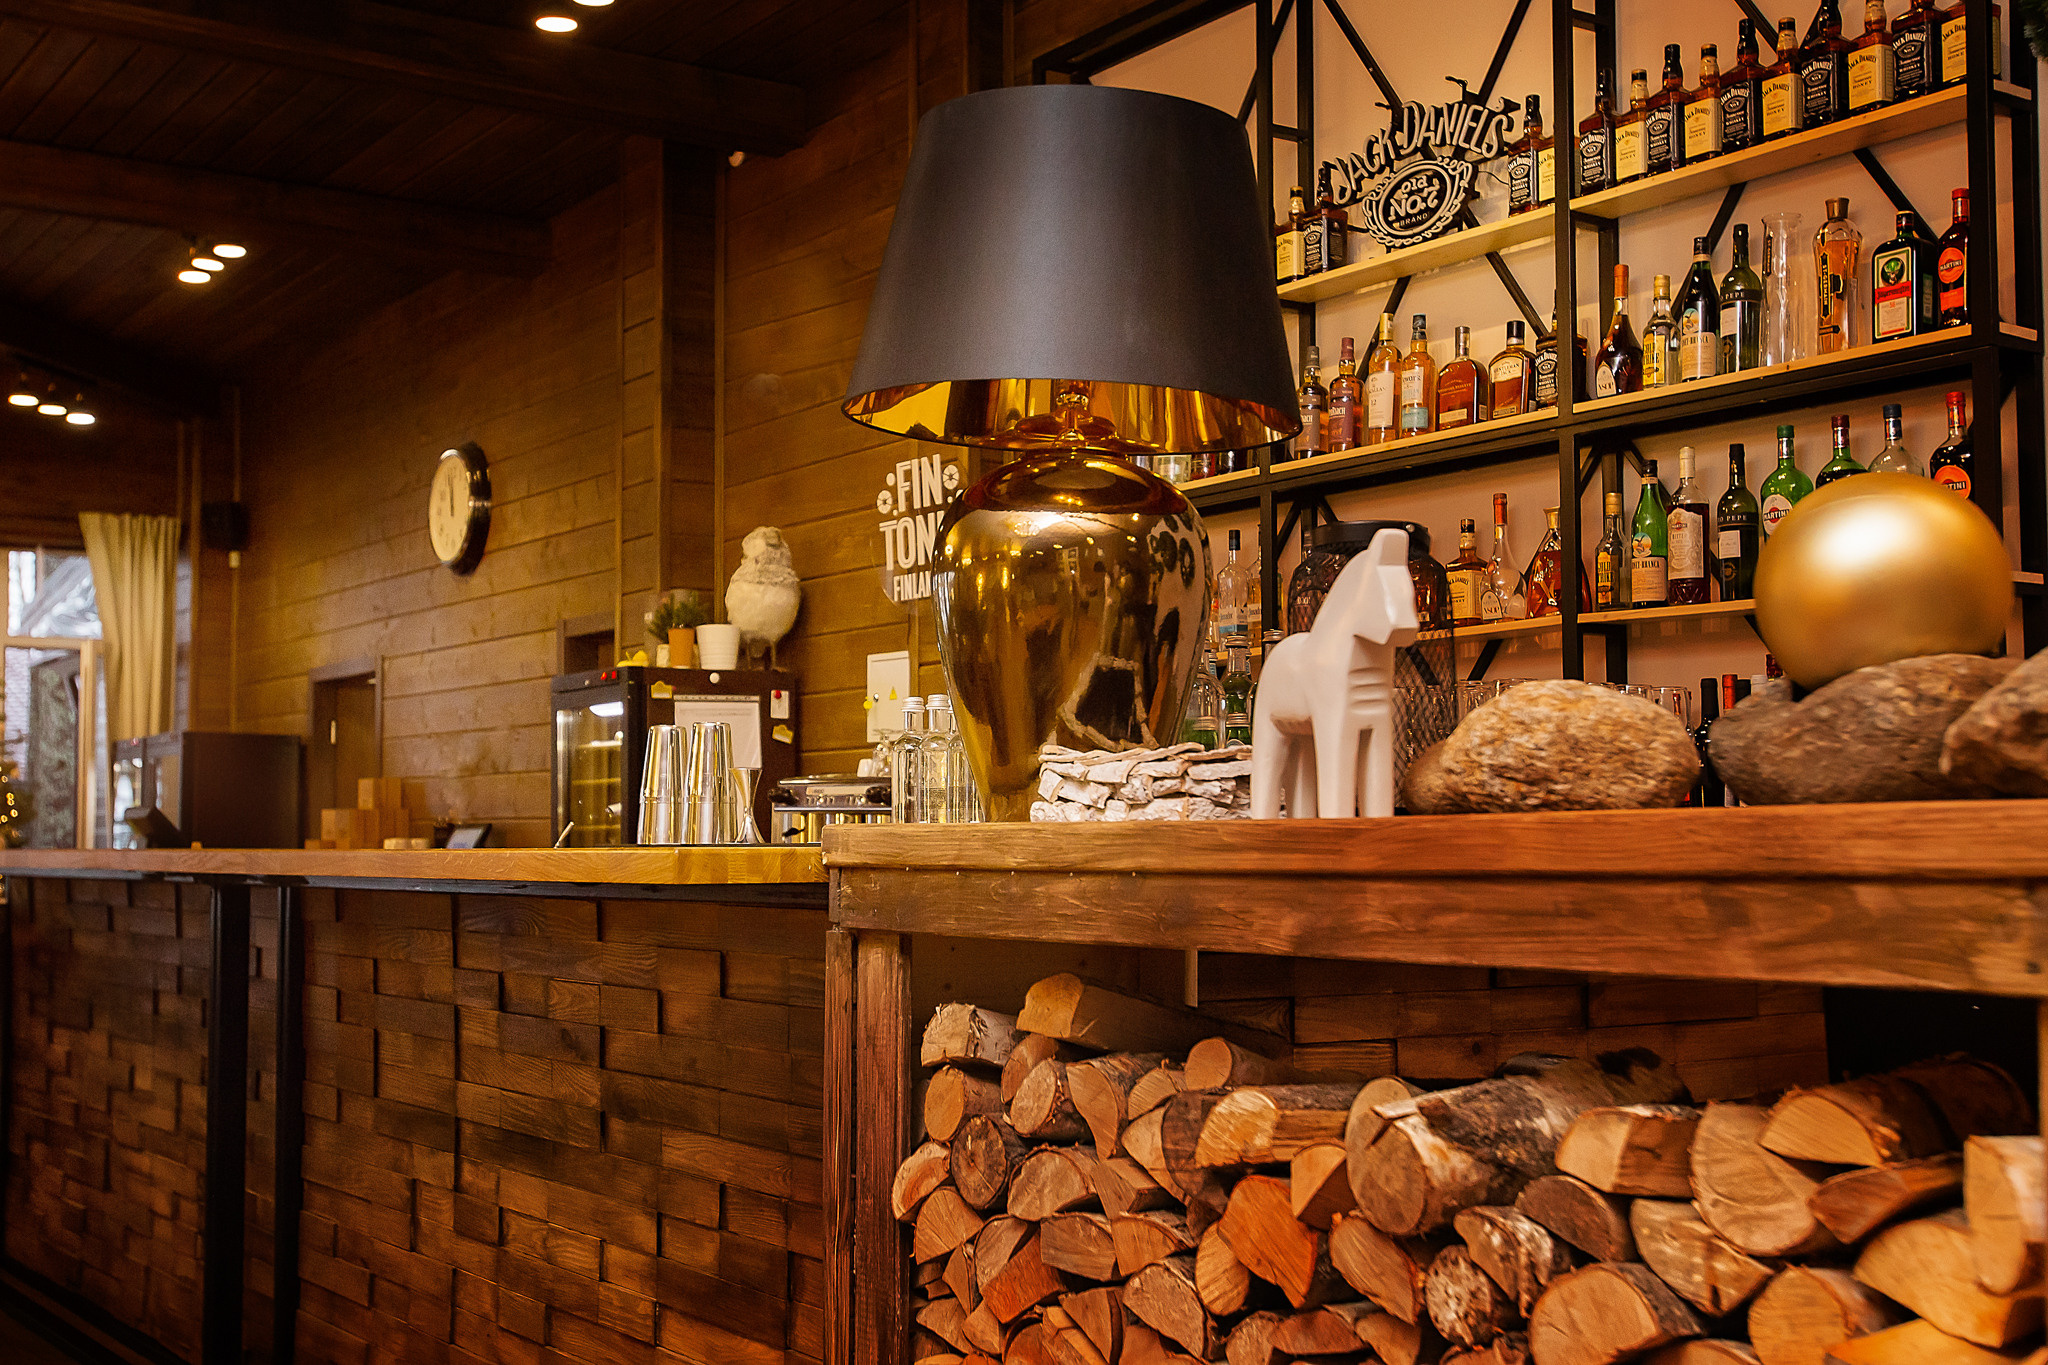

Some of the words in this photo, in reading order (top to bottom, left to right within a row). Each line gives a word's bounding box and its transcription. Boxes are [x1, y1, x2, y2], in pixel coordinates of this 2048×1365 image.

[1334, 123, 1396, 205] JACK
[1400, 212, 1429, 227] BRAND
[895, 453, 943, 513] FIN
